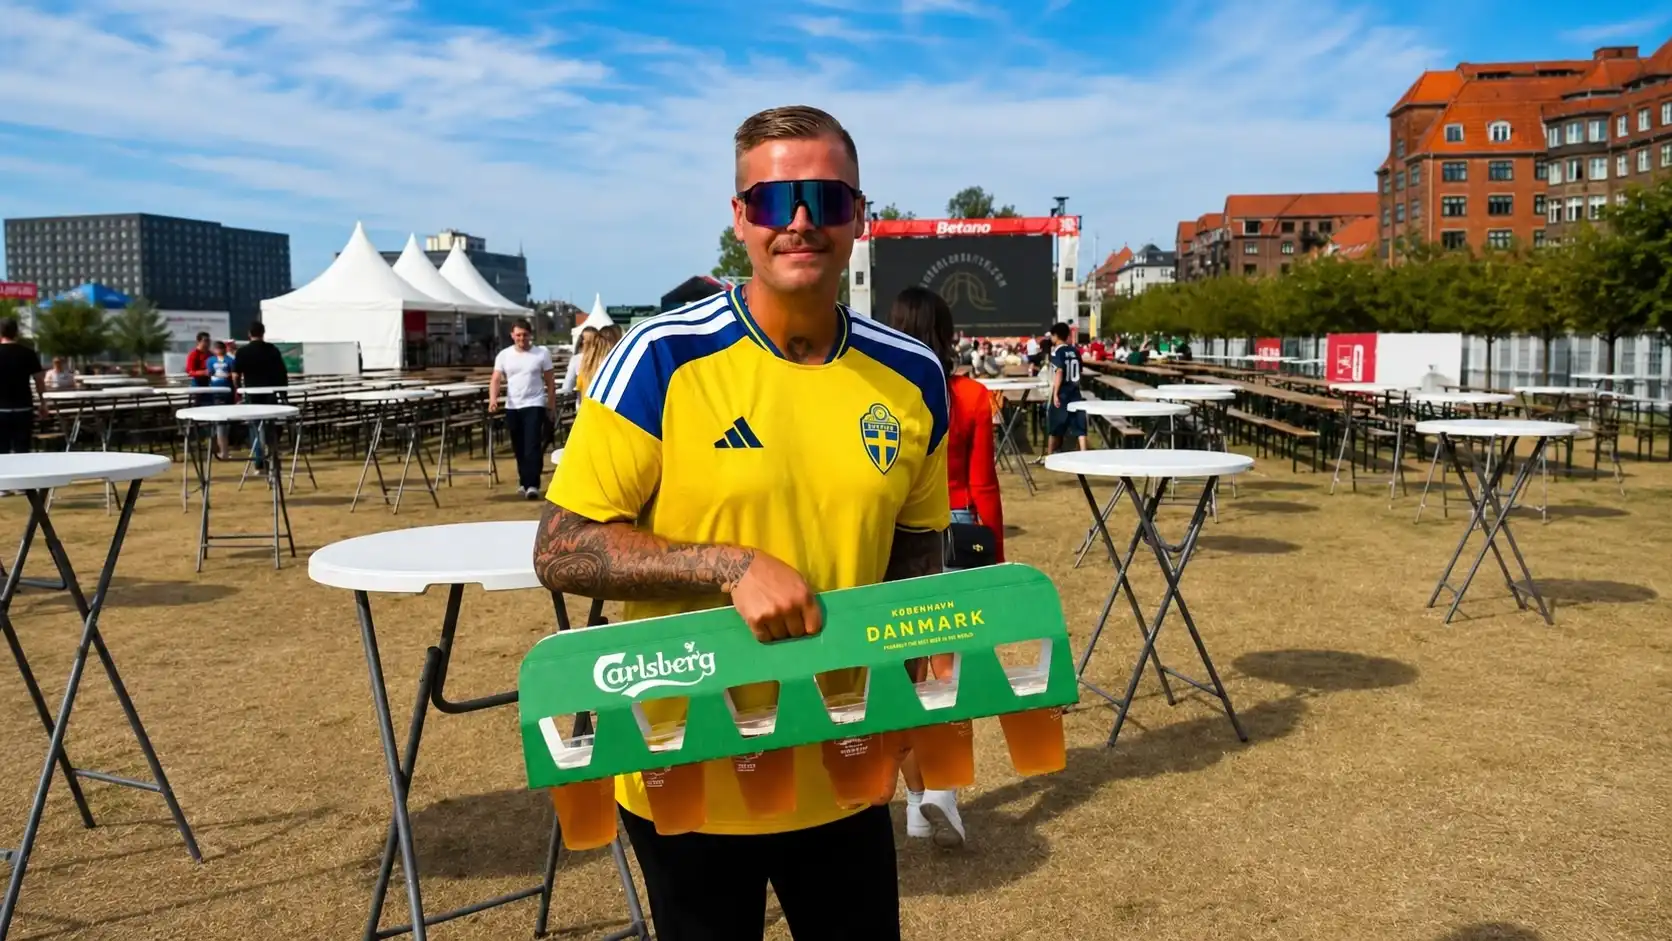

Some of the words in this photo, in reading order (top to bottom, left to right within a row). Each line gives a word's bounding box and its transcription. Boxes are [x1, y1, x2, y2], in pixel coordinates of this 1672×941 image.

[936, 220, 991, 234] Betano
[1065, 359, 1080, 382] 10
[866, 610, 985, 642] DANMARK
[593, 641, 716, 698] Carlsberg
